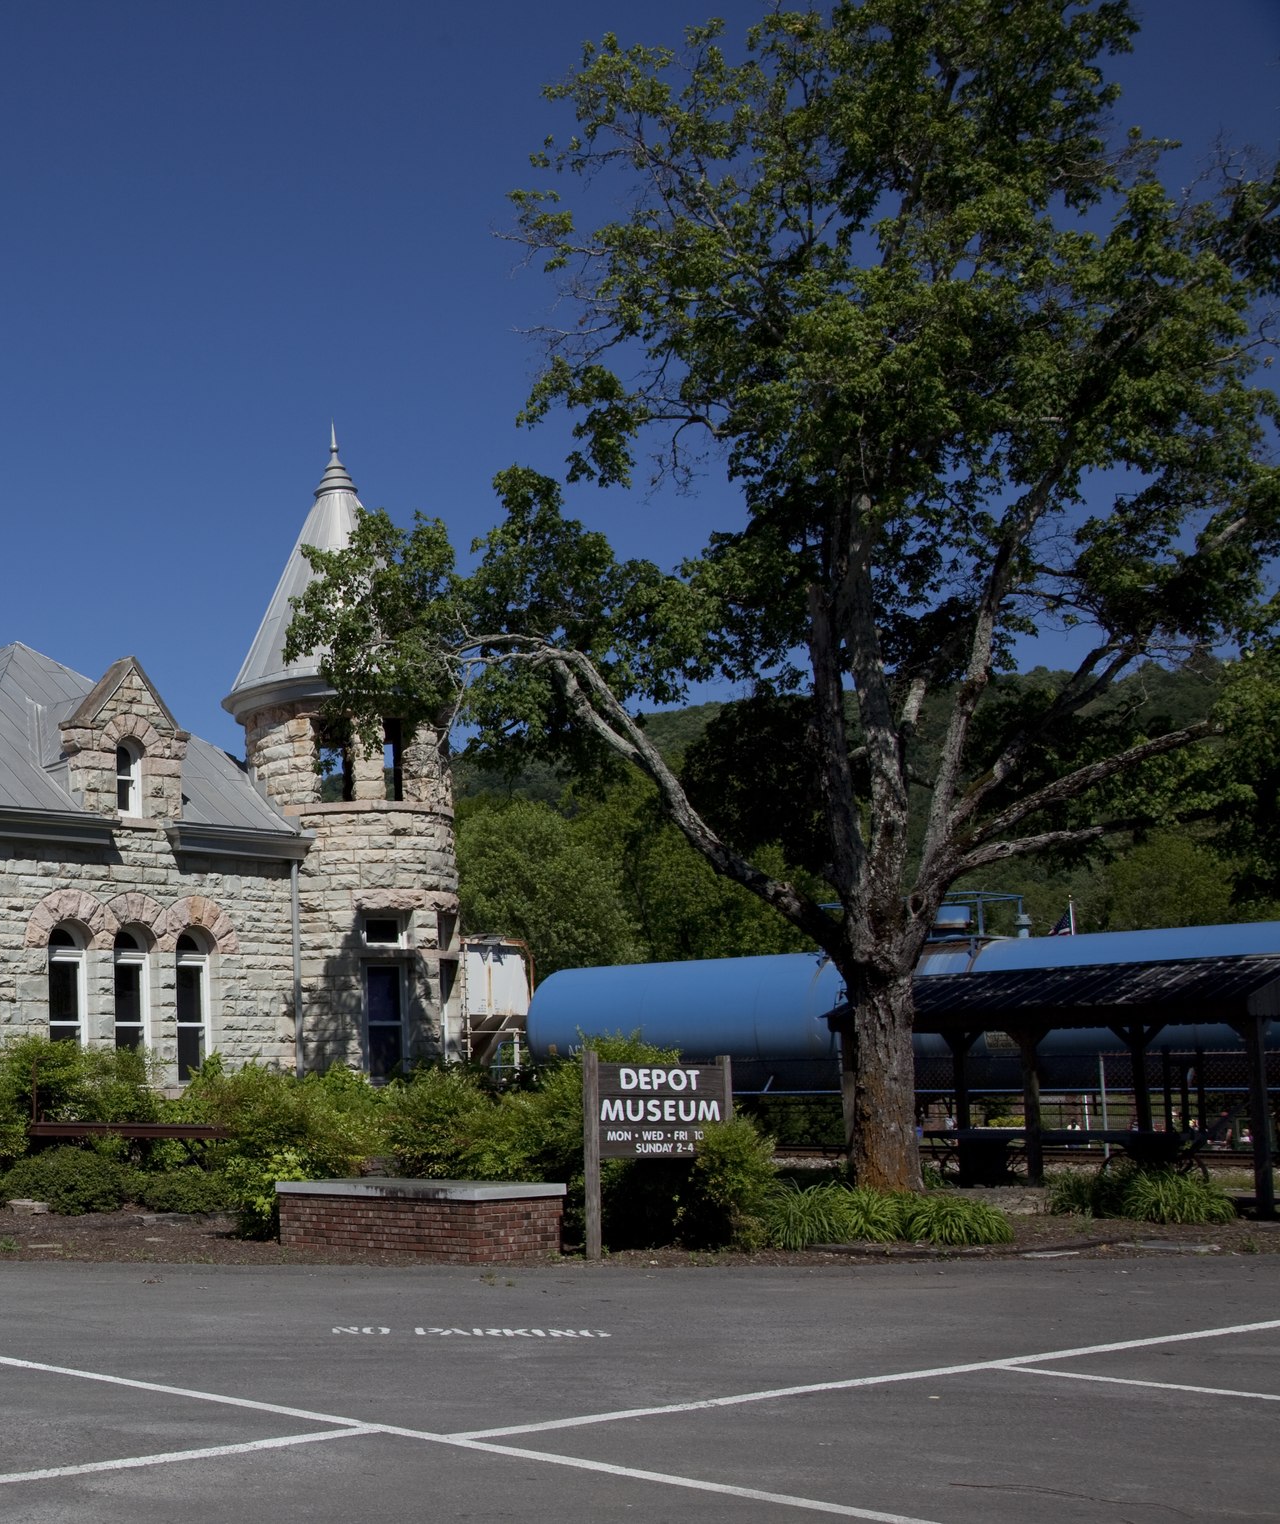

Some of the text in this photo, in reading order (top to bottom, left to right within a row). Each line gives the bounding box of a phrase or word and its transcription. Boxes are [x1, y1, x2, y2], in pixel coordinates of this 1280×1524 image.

[619, 1068, 700, 1091] DEPOT
[600, 1099, 721, 1122] MUSEUM
[606, 1130, 632, 1141] MON
[642, 1130, 664, 1141] WED
[674, 1130, 688, 1141] FRI
[635, 1142, 673, 1153] SUNDAY
[331, 1326, 612, 1338] NO PARKING
